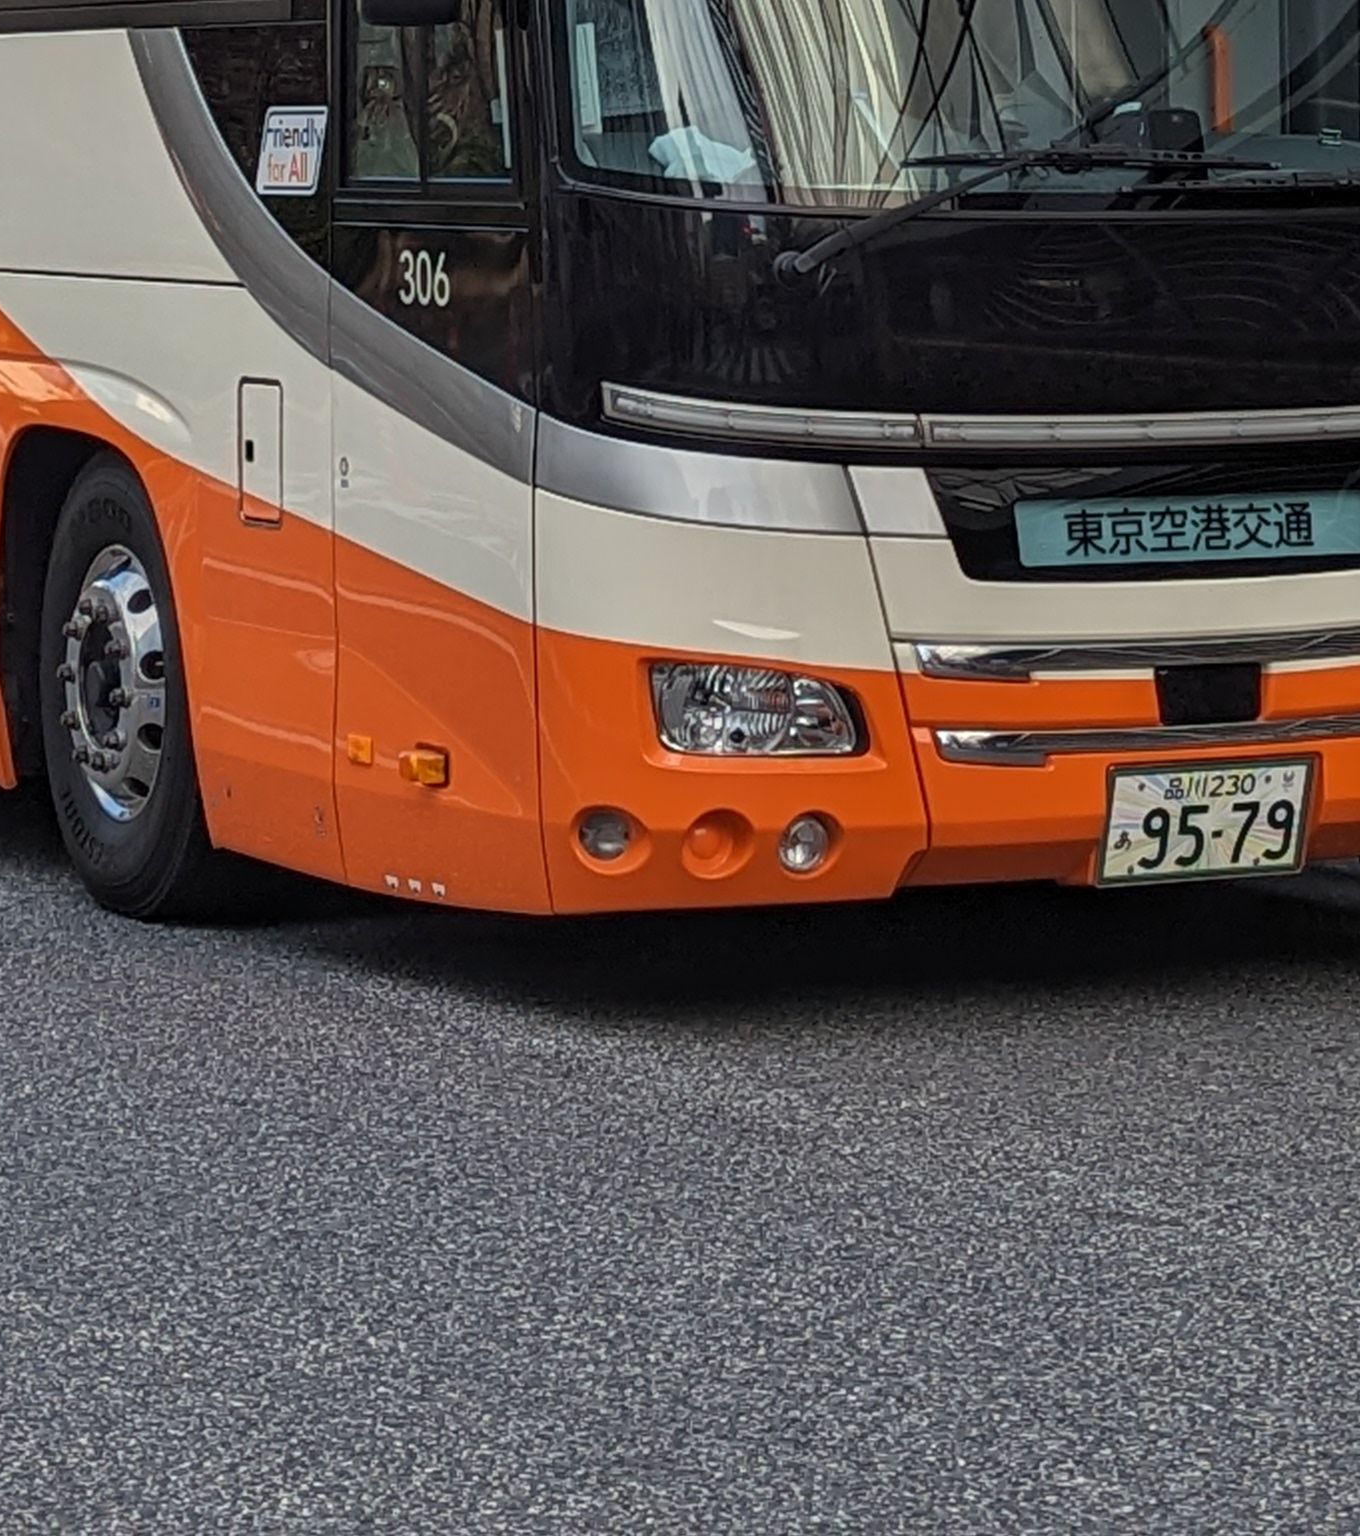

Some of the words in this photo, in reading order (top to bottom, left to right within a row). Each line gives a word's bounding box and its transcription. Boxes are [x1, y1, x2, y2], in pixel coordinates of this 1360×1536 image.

[266, 152, 286, 183] for
[288, 152, 309, 183] All
[397, 249, 451, 308] 306
[1063, 501, 1315, 557] 東京空港交通
[1113, 830, 1132, 851] あ
[1136, 798, 1296, 870] 95-79
